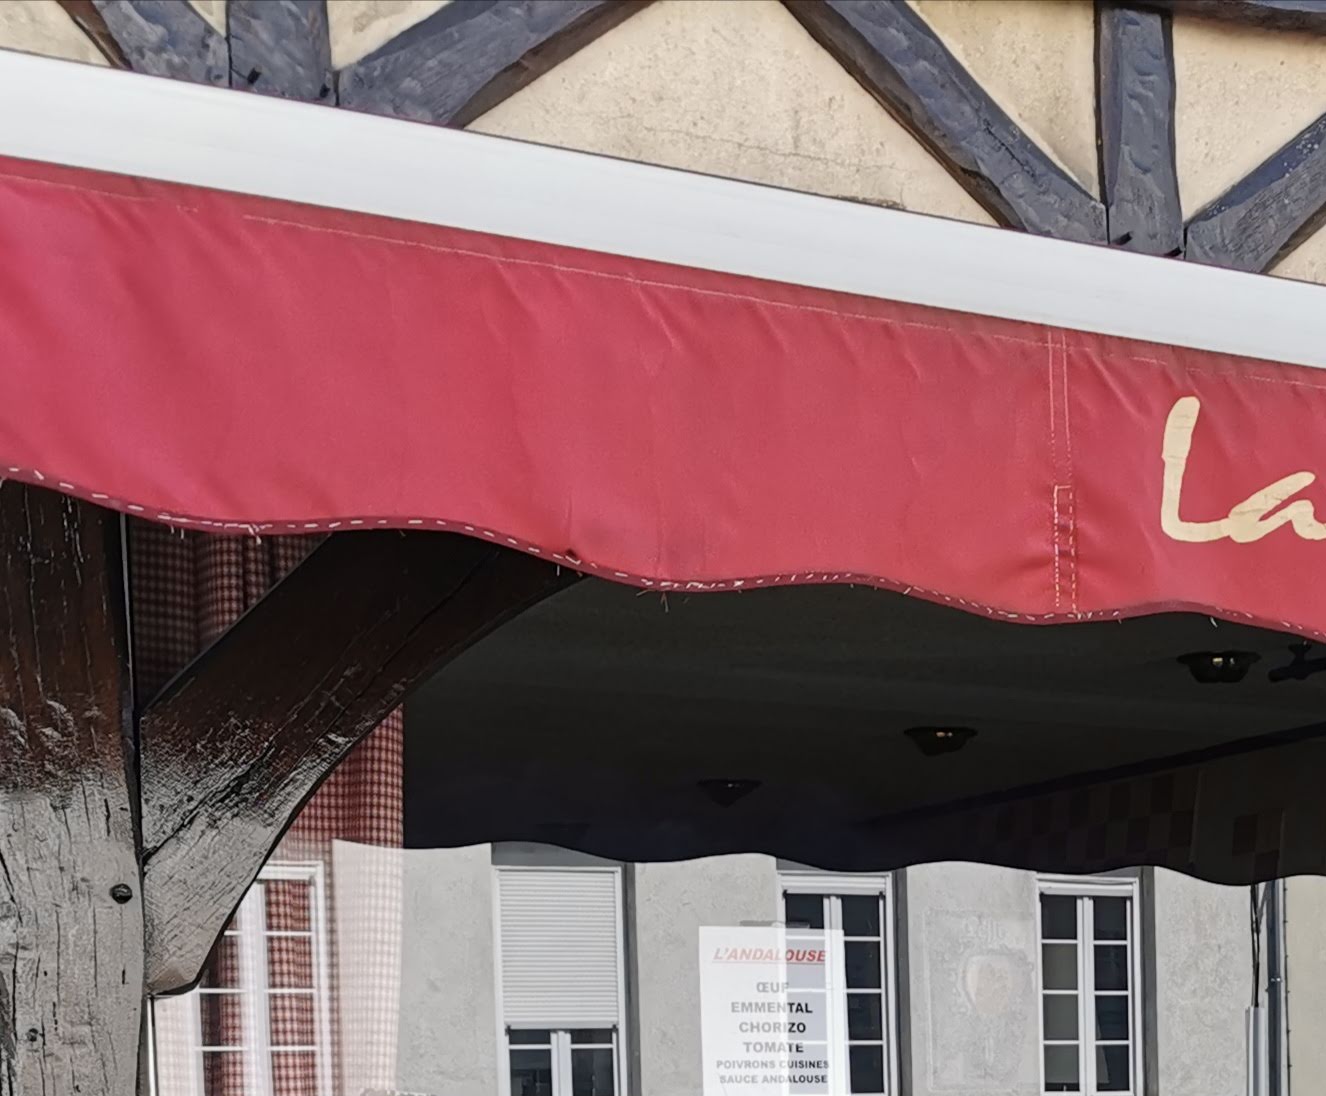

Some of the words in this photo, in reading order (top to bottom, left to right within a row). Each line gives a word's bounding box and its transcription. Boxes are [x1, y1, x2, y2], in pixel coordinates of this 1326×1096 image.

[712, 948, 827, 964] L'ANDALOUSE
[730, 1002, 813, 1014] EMMENTAL
[738, 1022, 807, 1033] CHORIZO
[743, 1042, 804, 1053] TOMATE
[716, 1060, 776, 1070] POIVRONS
[779, 1060, 830, 1070] CUISINES
[719, 1074, 758, 1084] SAUCE
[761, 1074, 828, 1084] ANDALOUSE
